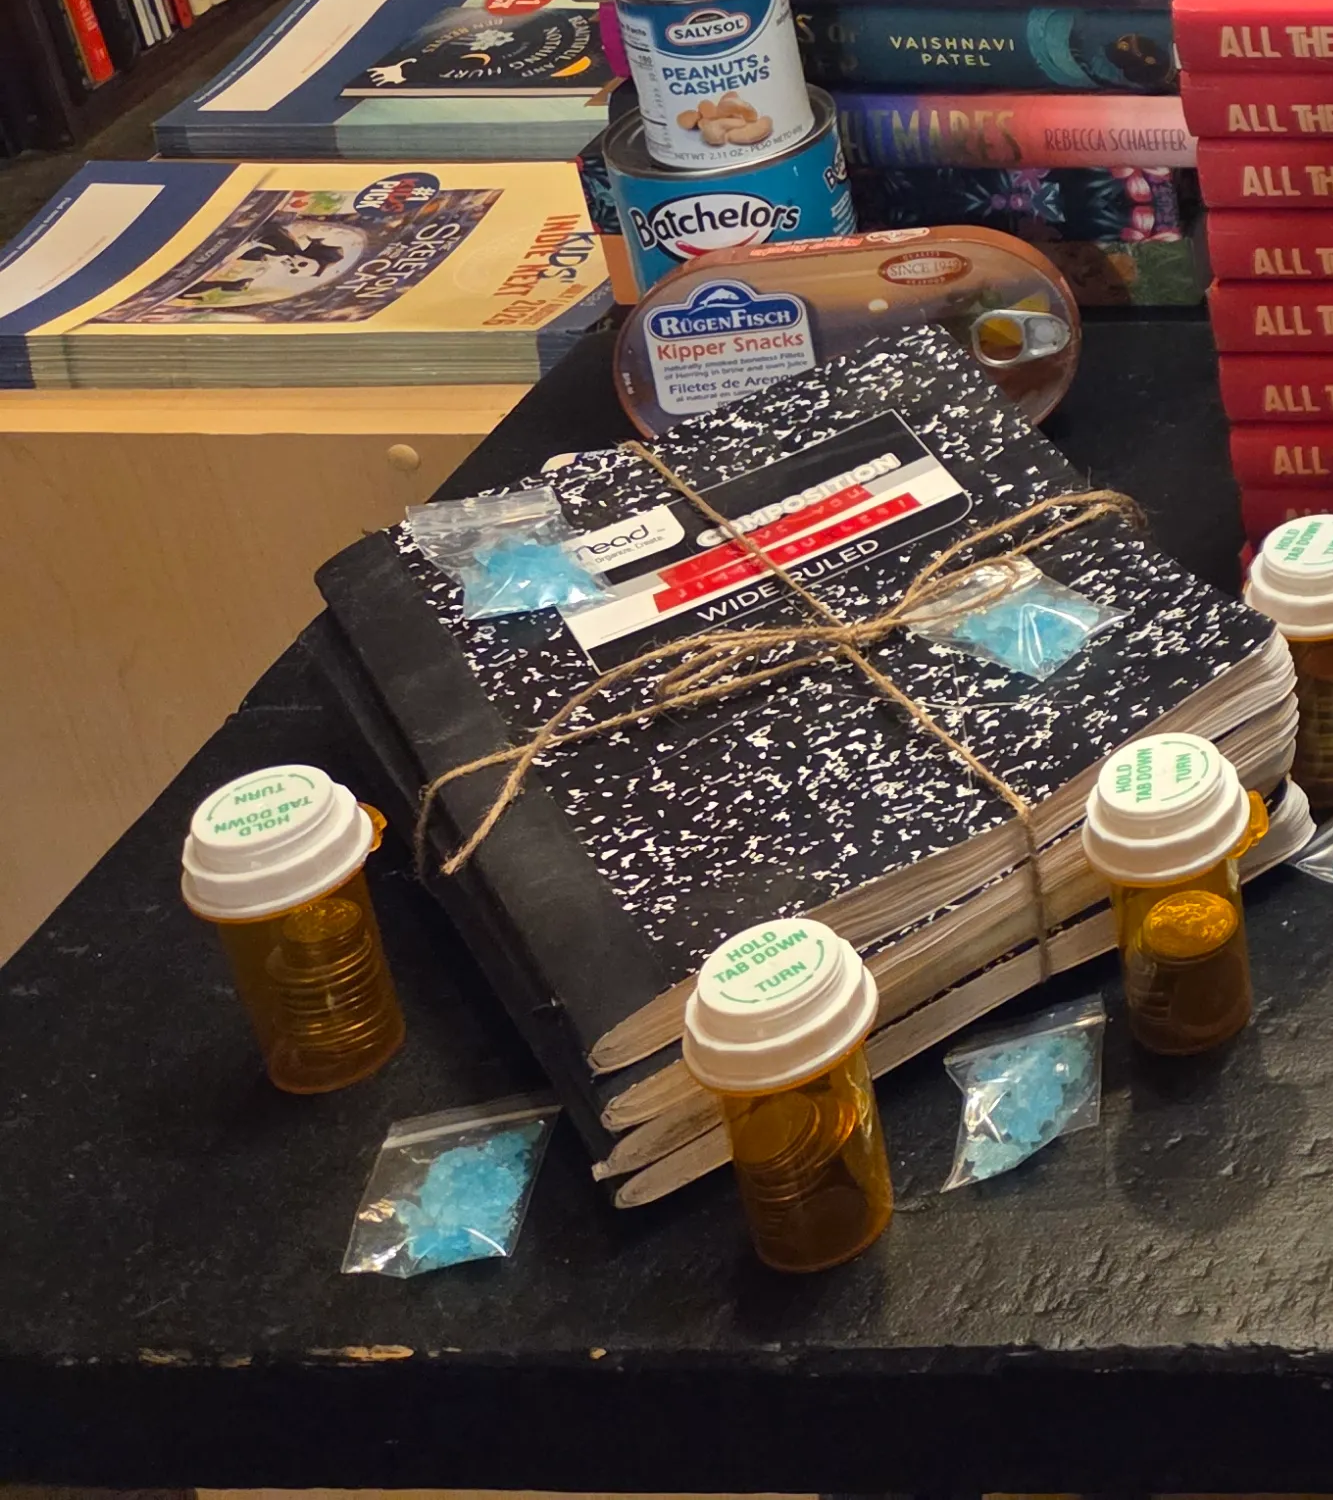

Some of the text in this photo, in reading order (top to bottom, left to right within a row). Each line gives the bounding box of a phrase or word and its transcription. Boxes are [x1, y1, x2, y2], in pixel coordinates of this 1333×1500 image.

[673, 19, 745, 40] SALYSOL
[889, 34, 1016, 53] VAISHNAVI
[661, 53, 759, 82] PEANUTS
[921, 52, 992, 69] PATEL
[668, 65, 771, 96] CASHEWS
[1043, 126, 1188, 153] REBECCA SCHAEFFER
[355, 180, 401, 209] PICK
[523, 213, 582, 260] INDIE
[629, 200, 801, 250] Batchelors
[335, 259, 391, 294] CAT
[354, 222, 462, 299] SKELETON
[887, 260, 931, 278] SINCE
[656, 329, 805, 364] Kipper Snacks
[669, 377, 741, 396] Filetes de
[697, 452, 902, 548] COMPOSITION
[696, 584, 781, 623] WIDE
[792, 537, 880, 583] RULED
[712, 928, 809, 984] TAB DOWN
[725, 930, 778, 963] HOLD
[753, 960, 808, 993] TURN
